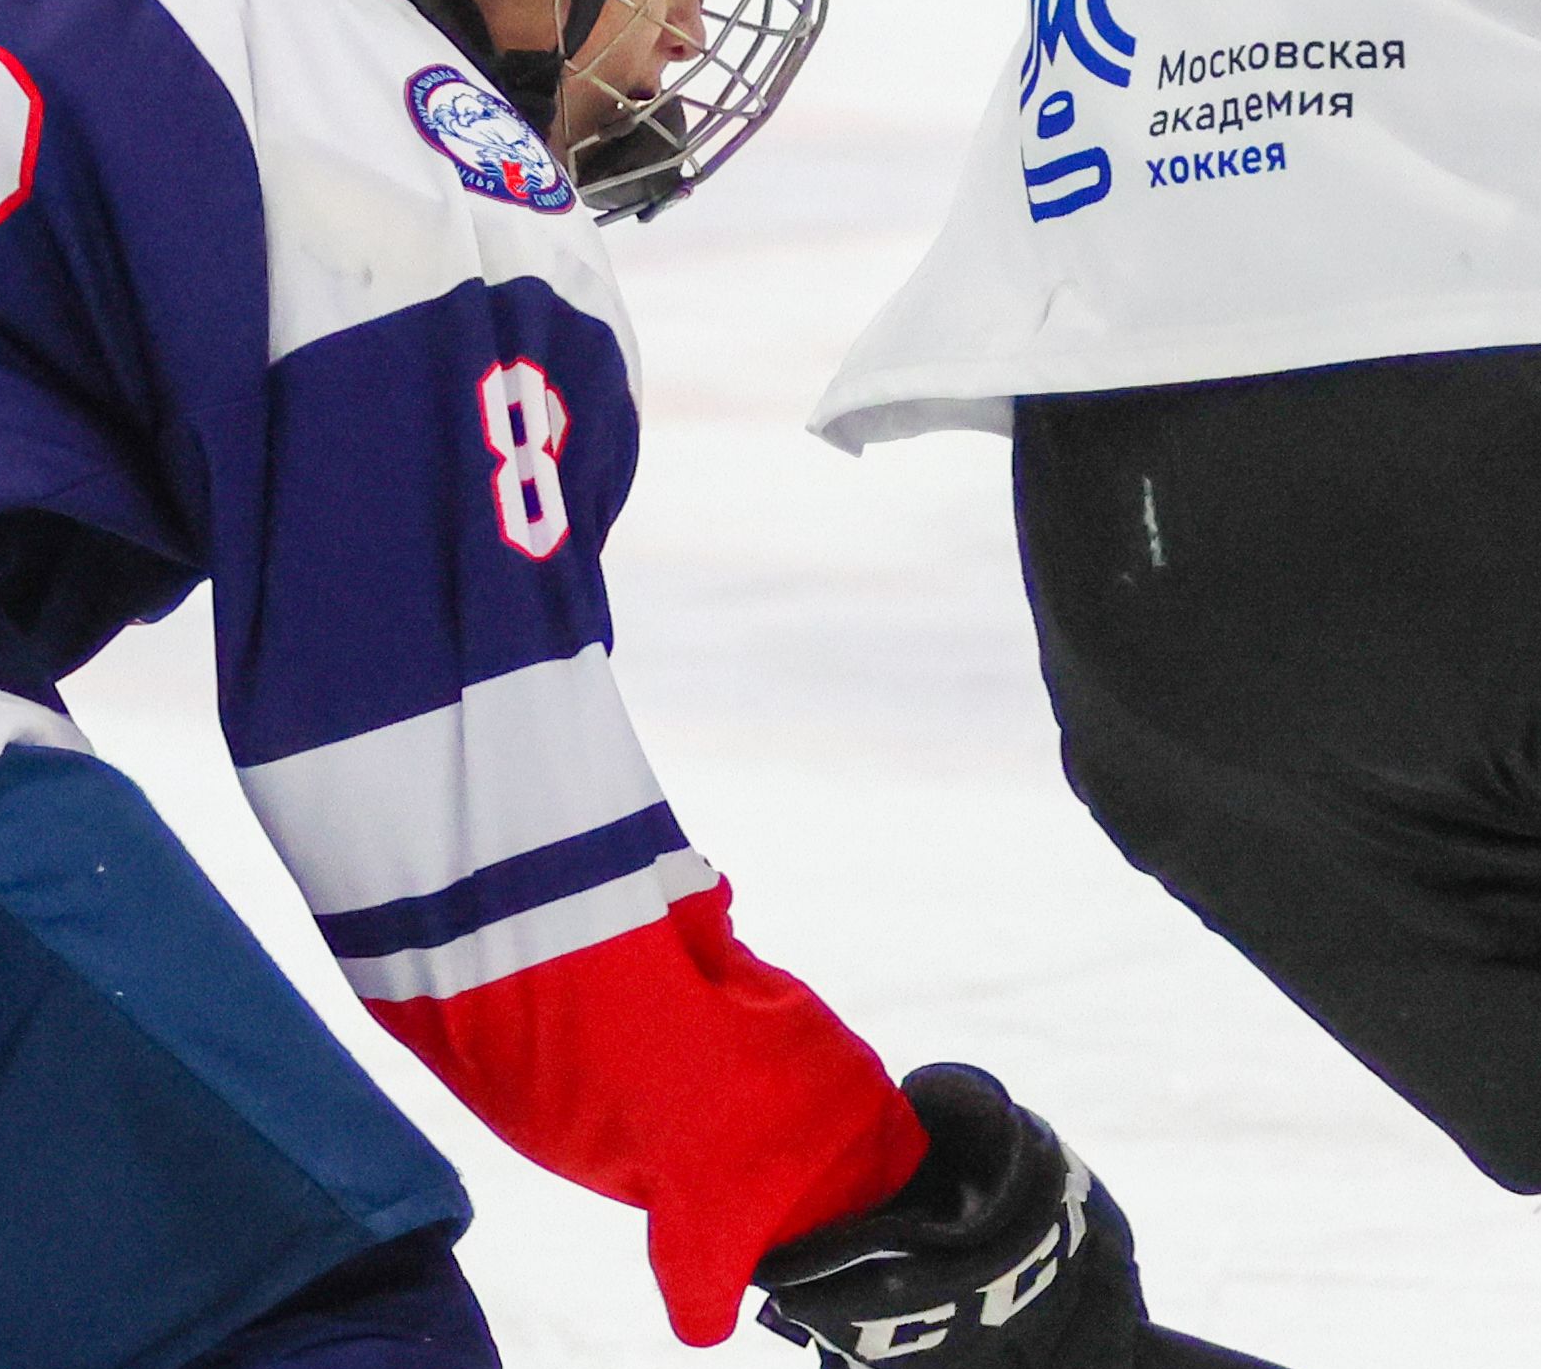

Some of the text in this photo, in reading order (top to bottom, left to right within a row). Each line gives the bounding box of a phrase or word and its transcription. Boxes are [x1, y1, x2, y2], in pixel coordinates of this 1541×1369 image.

[1157, 38, 1406, 90] Московская
[1148, 88, 1354, 137] академия
[1146, 141, 1286, 188] хоккея
[476, 355, 572, 553] 8
